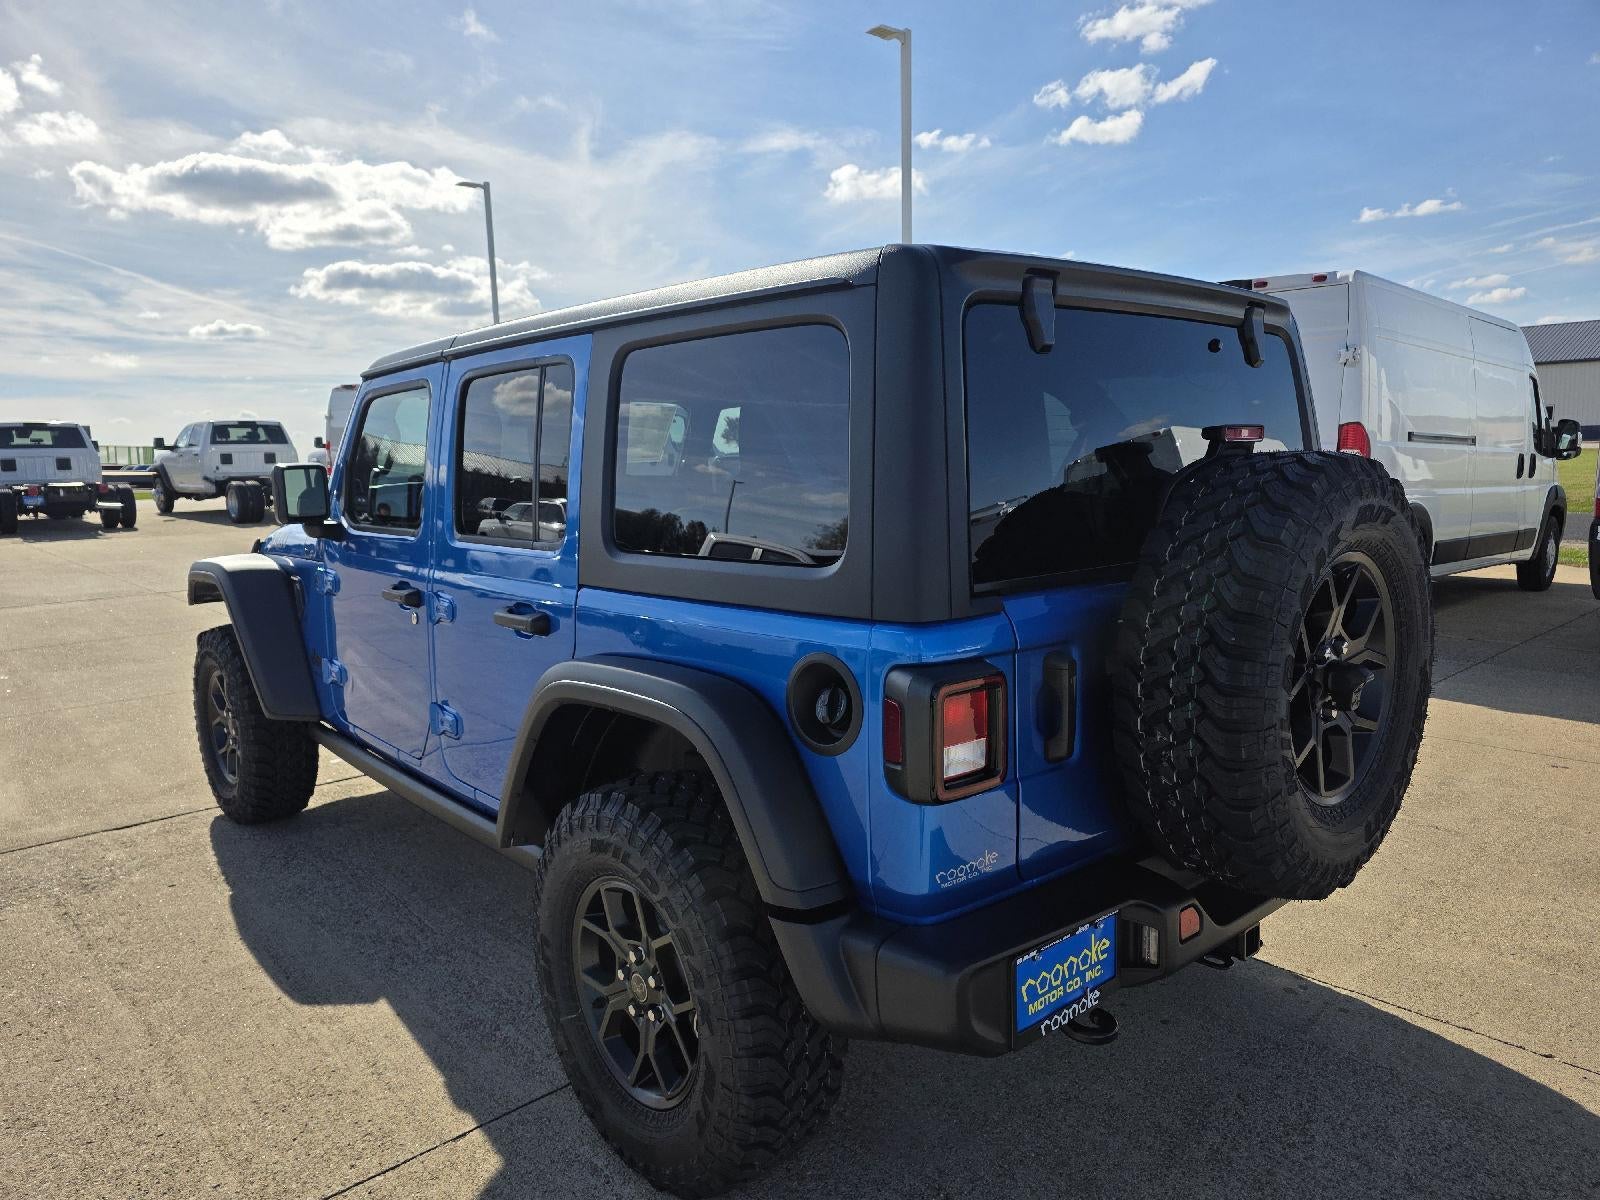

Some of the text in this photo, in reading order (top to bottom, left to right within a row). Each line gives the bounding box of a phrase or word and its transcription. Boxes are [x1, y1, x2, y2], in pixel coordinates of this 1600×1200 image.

[941, 875, 967, 888] MOTOR
[1028, 964, 1104, 1016] MOTOR CO. INC.
